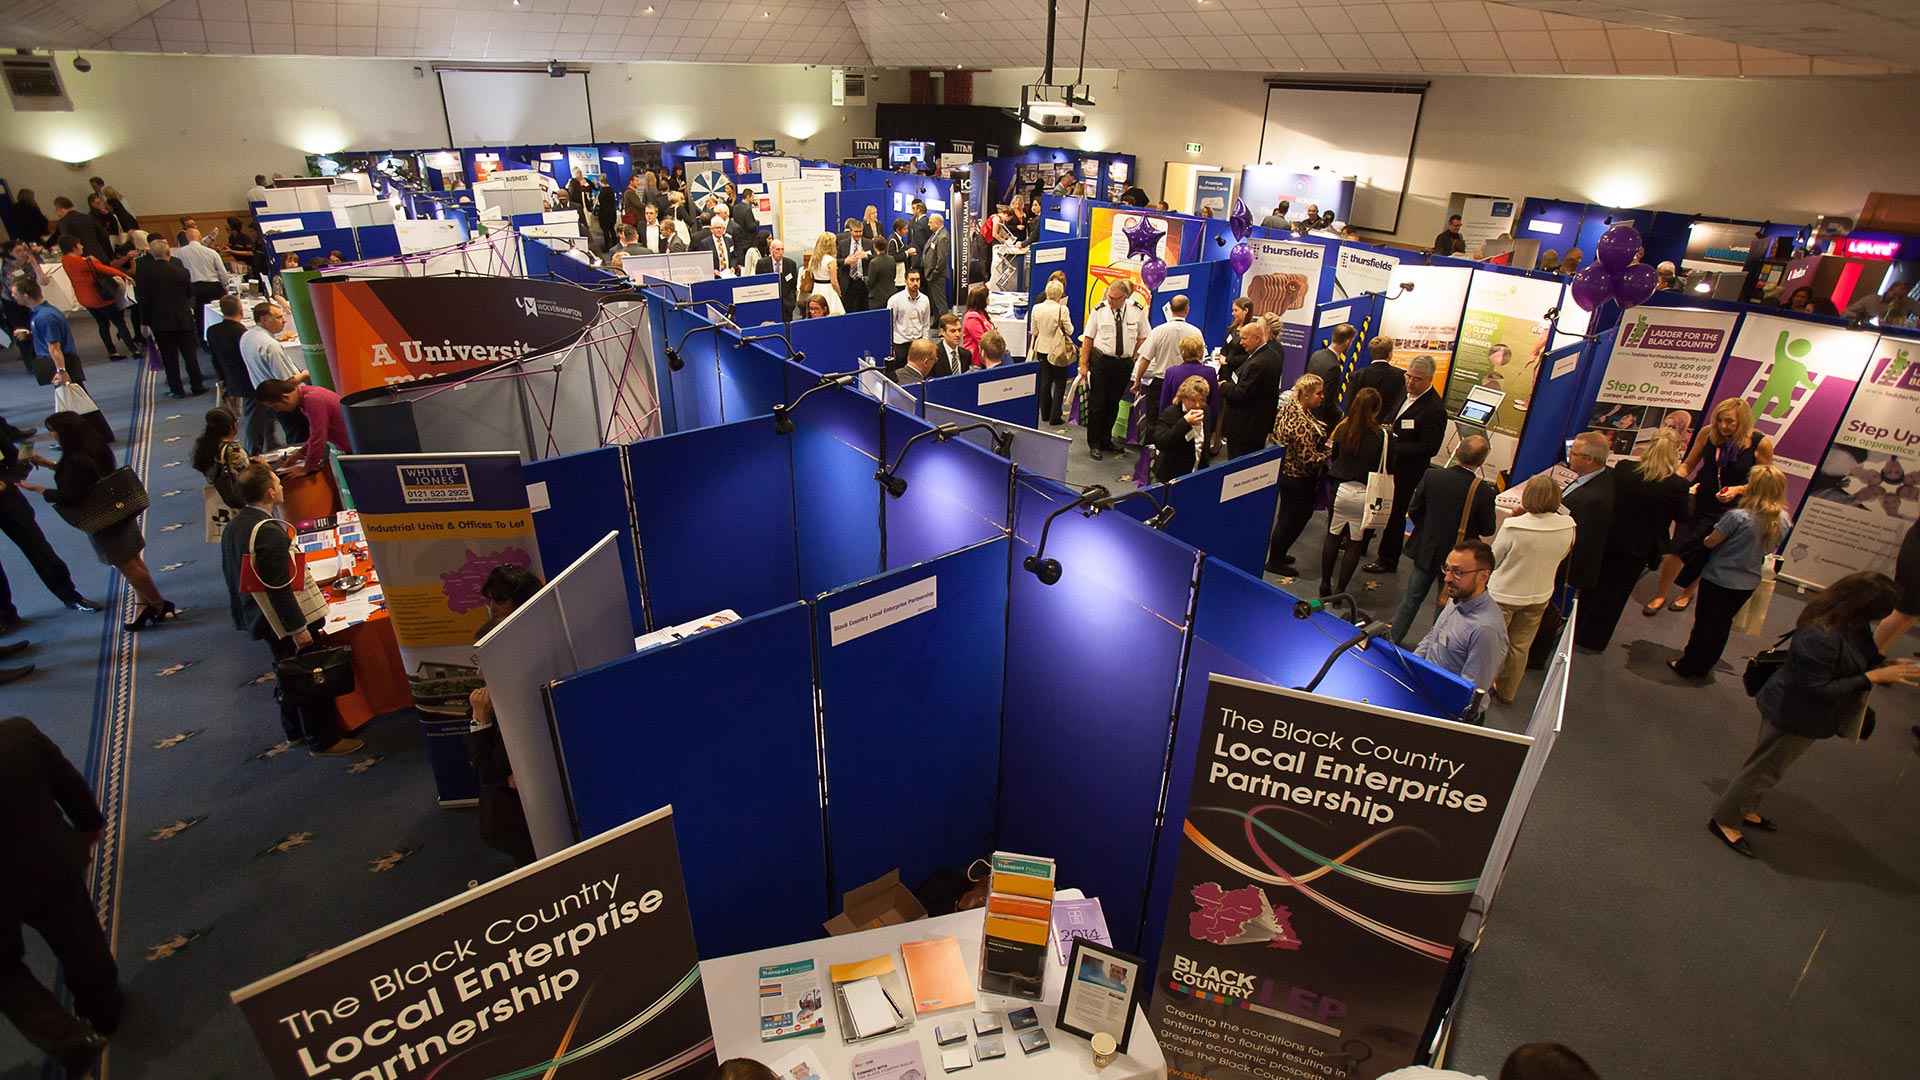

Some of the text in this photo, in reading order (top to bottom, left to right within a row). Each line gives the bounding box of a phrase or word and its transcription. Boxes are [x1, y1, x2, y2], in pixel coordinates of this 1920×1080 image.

[855, 140, 880, 150] TITAN
[953, 143, 973, 153] TITAN
[962, 200, 970, 288] www.in-comm.co.uk
[1262, 245, 1320, 259] thursfields
[1349, 254, 1393, 272] thursfields
[537, 304, 582, 317] WOLVERHAMPTON
[1648, 338, 1716, 350] BLACK COUNTRY
[1651, 330, 1682, 339] LADDER
[1684, 332, 1700, 340] FOR
[371, 339, 540, 367] A Universit
[1617, 352, 1714, 362] www.ladderfortheblackcountry.co.uk
[1653, 362, 1712, 373] 03332 409 699
[1606, 380, 1637, 394] Step
[1640, 382, 1660, 394] On
[1669, 380, 1705, 388] @ladder4bc
[1848, 420, 1920, 446] Step Up
[1843, 434, 1916, 456] an apprentice
[406, 468, 459, 477] WHITTLE
[416, 476, 455, 486] JONES
[407, 490, 428, 498] 0121
[449, 489, 469, 497] 2929
[367, 523, 415, 533] Industrial
[418, 522, 444, 530] Units
[458, 521, 493, 530] Offices
[494, 520, 506, 529] To
[509, 520, 525, 528] Let
[834, 591, 935, 632] Black Country Local Enterprise Partnership
[1220, 707, 1465, 780] The Black Country
[1214, 733, 1488, 813] Local Enterprise
[1209, 762, 1394, 825] Partnership
[998, 863, 1025, 871] Transport
[1060, 928, 1100, 942] 2014
[279, 873, 621, 1040] The Black Country
[763, 968, 789, 976] Transport
[1173, 954, 1257, 991] BLACK
[297, 889, 664, 1077] Local Enterprise
[1171, 969, 1254, 1000] COUNTRY
[1260, 978, 1349, 1023] LEP
[329, 968, 581, 1080] artnership
[1165, 1004, 1325, 1058] Creating the conditions for
[1160, 1028, 1203, 1048] greater
[1206, 1043, 1266, 1065] economic
[1162, 1017, 1347, 1078] enterprise to flourish resulting in
[1158, 1040, 1194, 1057] across
[1197, 1051, 1216, 1064] the
[1218, 1057, 1251, 1074] Black
[857, 1067, 876, 1076] CONNECT
